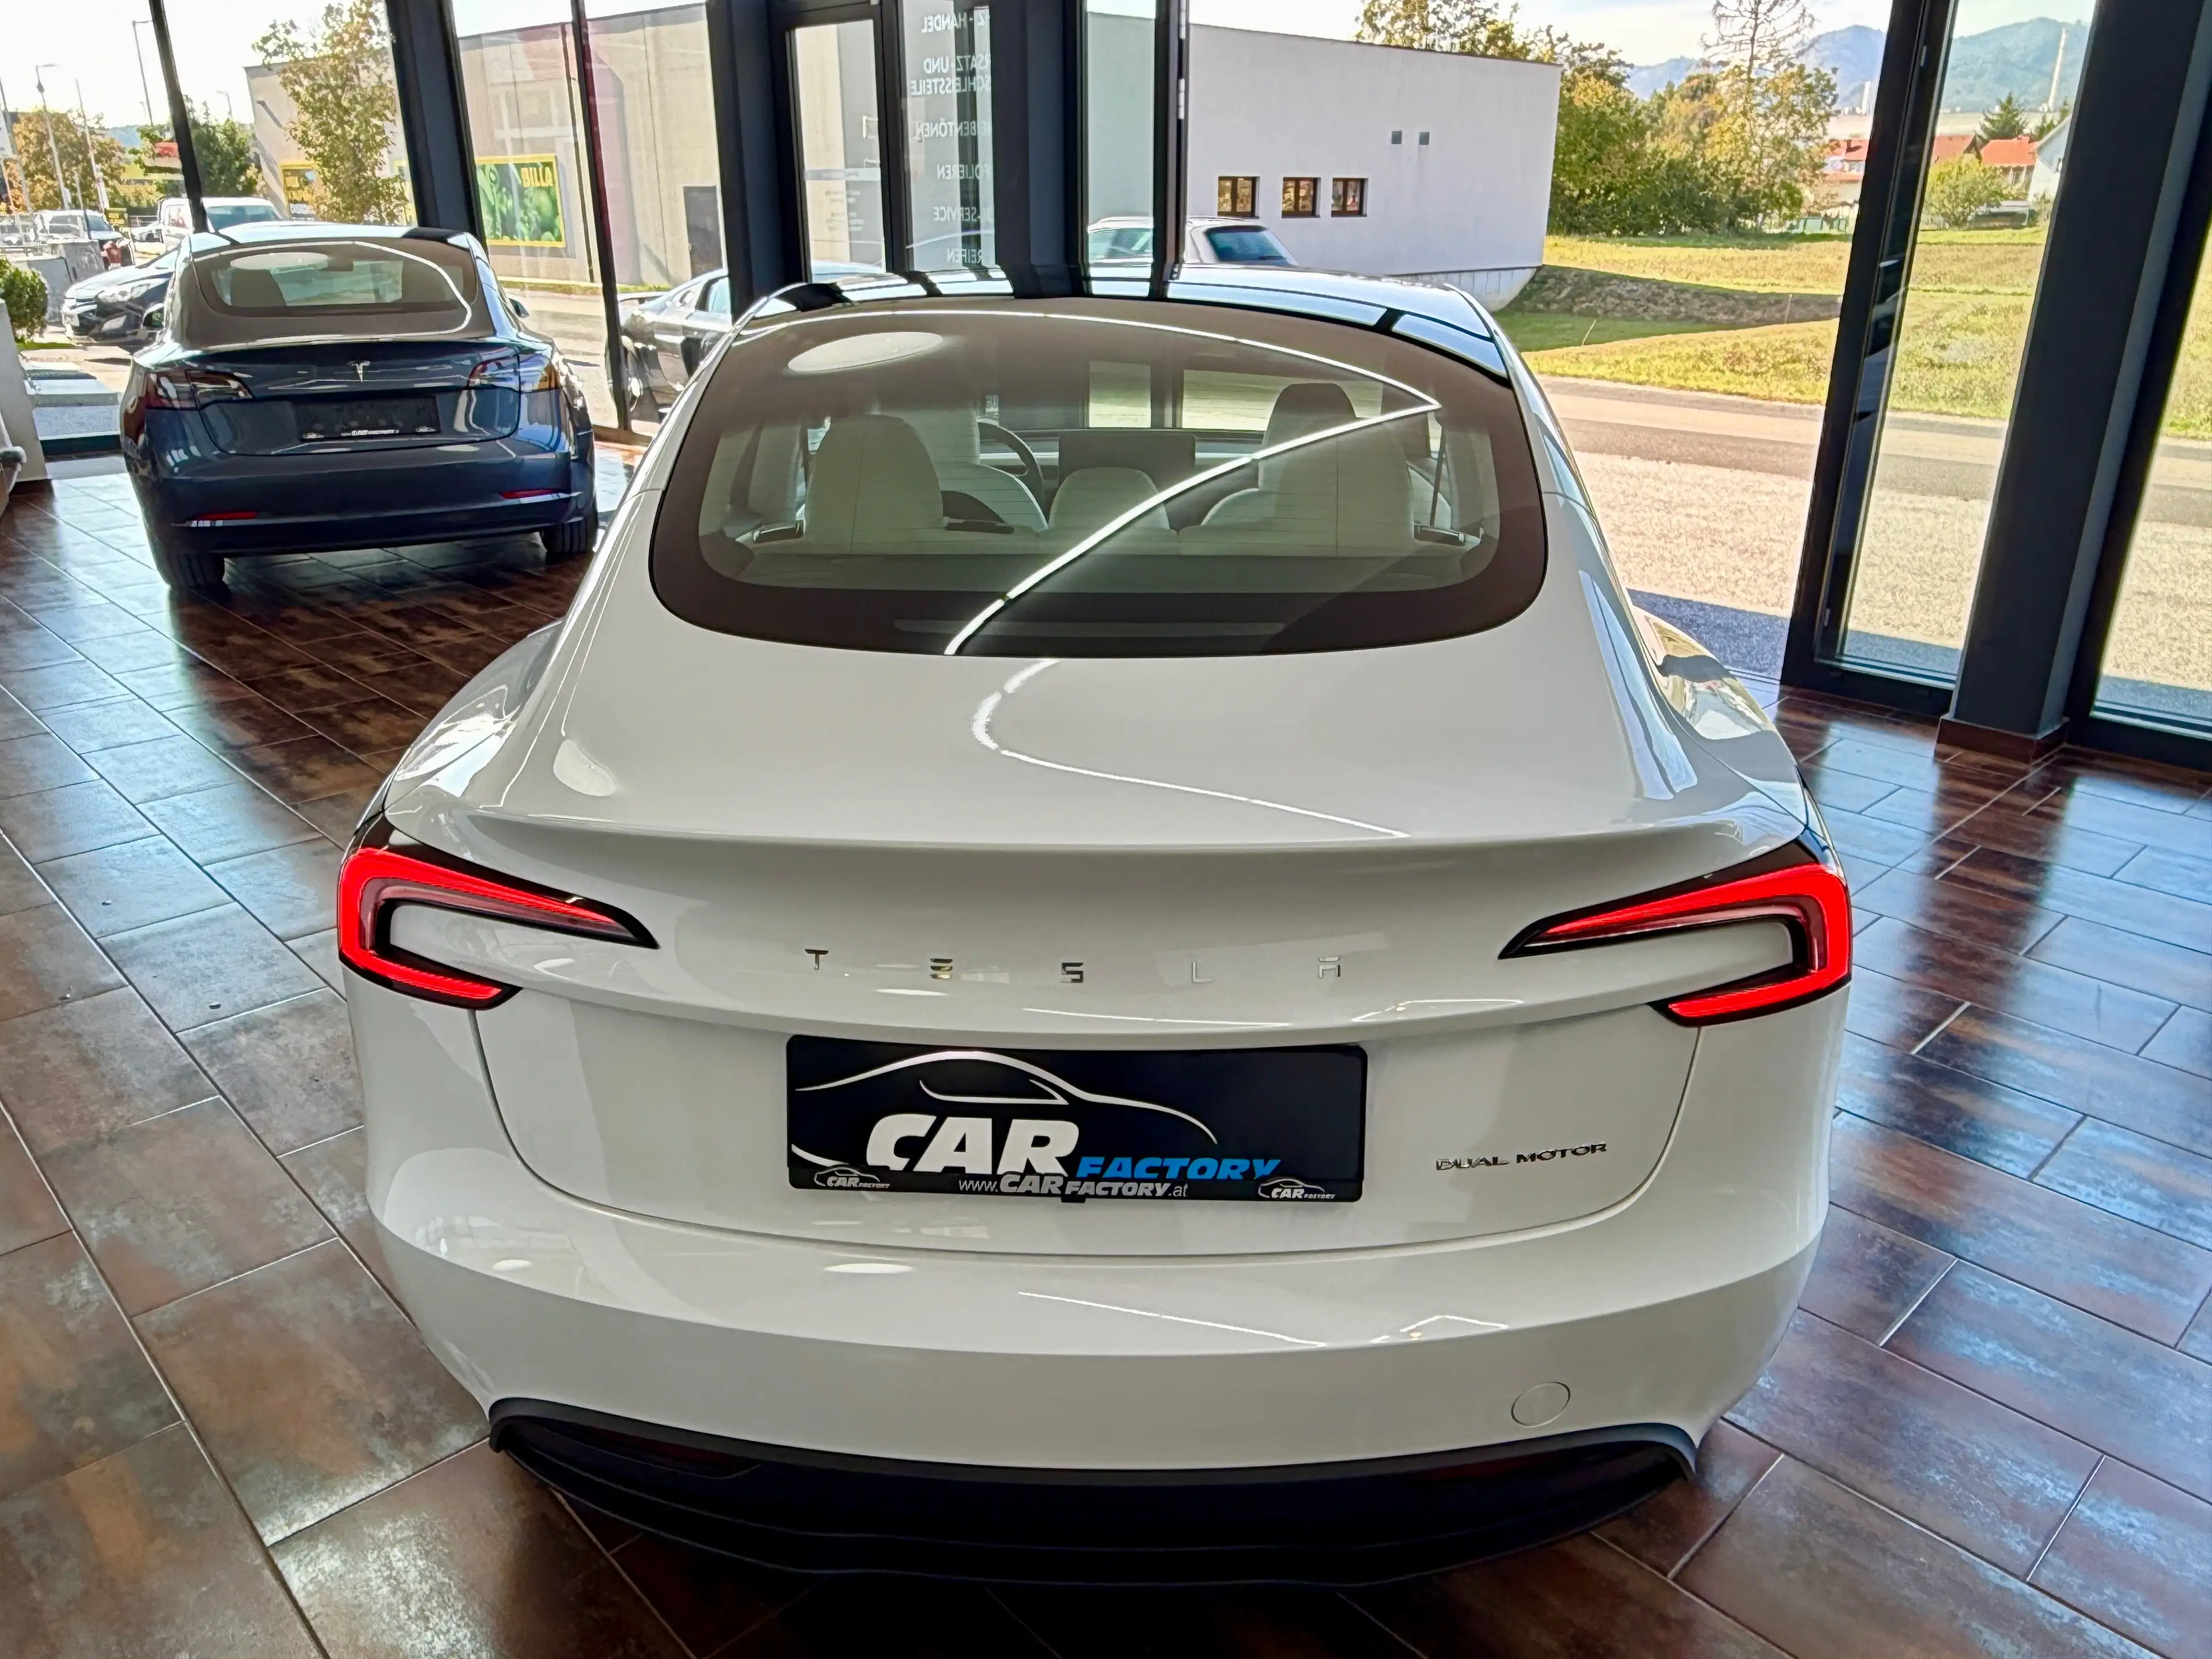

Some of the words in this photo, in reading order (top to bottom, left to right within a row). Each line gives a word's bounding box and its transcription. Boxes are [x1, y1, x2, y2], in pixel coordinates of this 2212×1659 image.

[521, 166, 554, 188] BILLA
[866, 1113, 1080, 1175] CAR
[1436, 1156, 1509, 1171] DUAL
[1516, 1142, 1607, 1164] MOTOR
[1076, 1157, 1281, 1180] FACTORY
[827, 1176, 860, 1187] CAR
[1271, 1188, 1305, 1199] CAR
